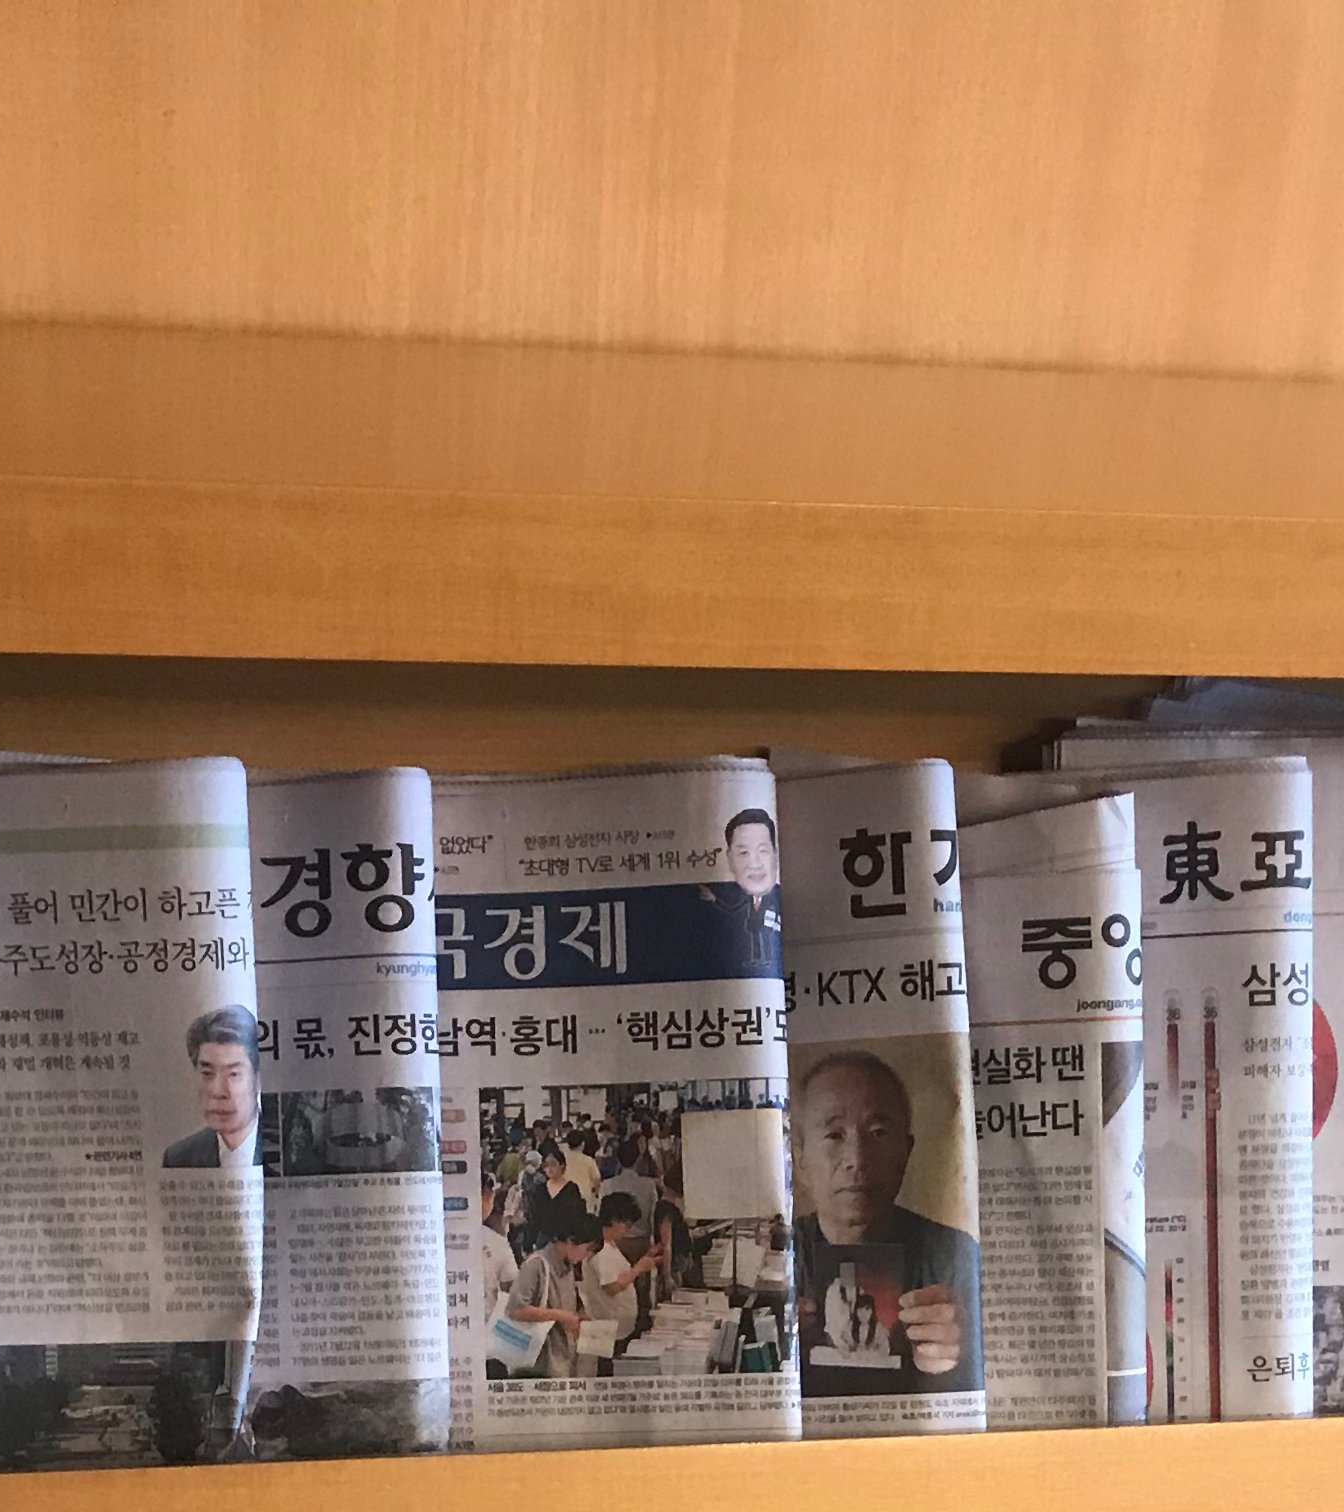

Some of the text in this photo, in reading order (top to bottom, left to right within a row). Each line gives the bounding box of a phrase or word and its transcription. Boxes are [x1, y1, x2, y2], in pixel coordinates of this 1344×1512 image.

[7, 889, 58, 924] 풀어
[69, 888, 148, 922] 민간이
[259, 842, 426, 937] 경향
